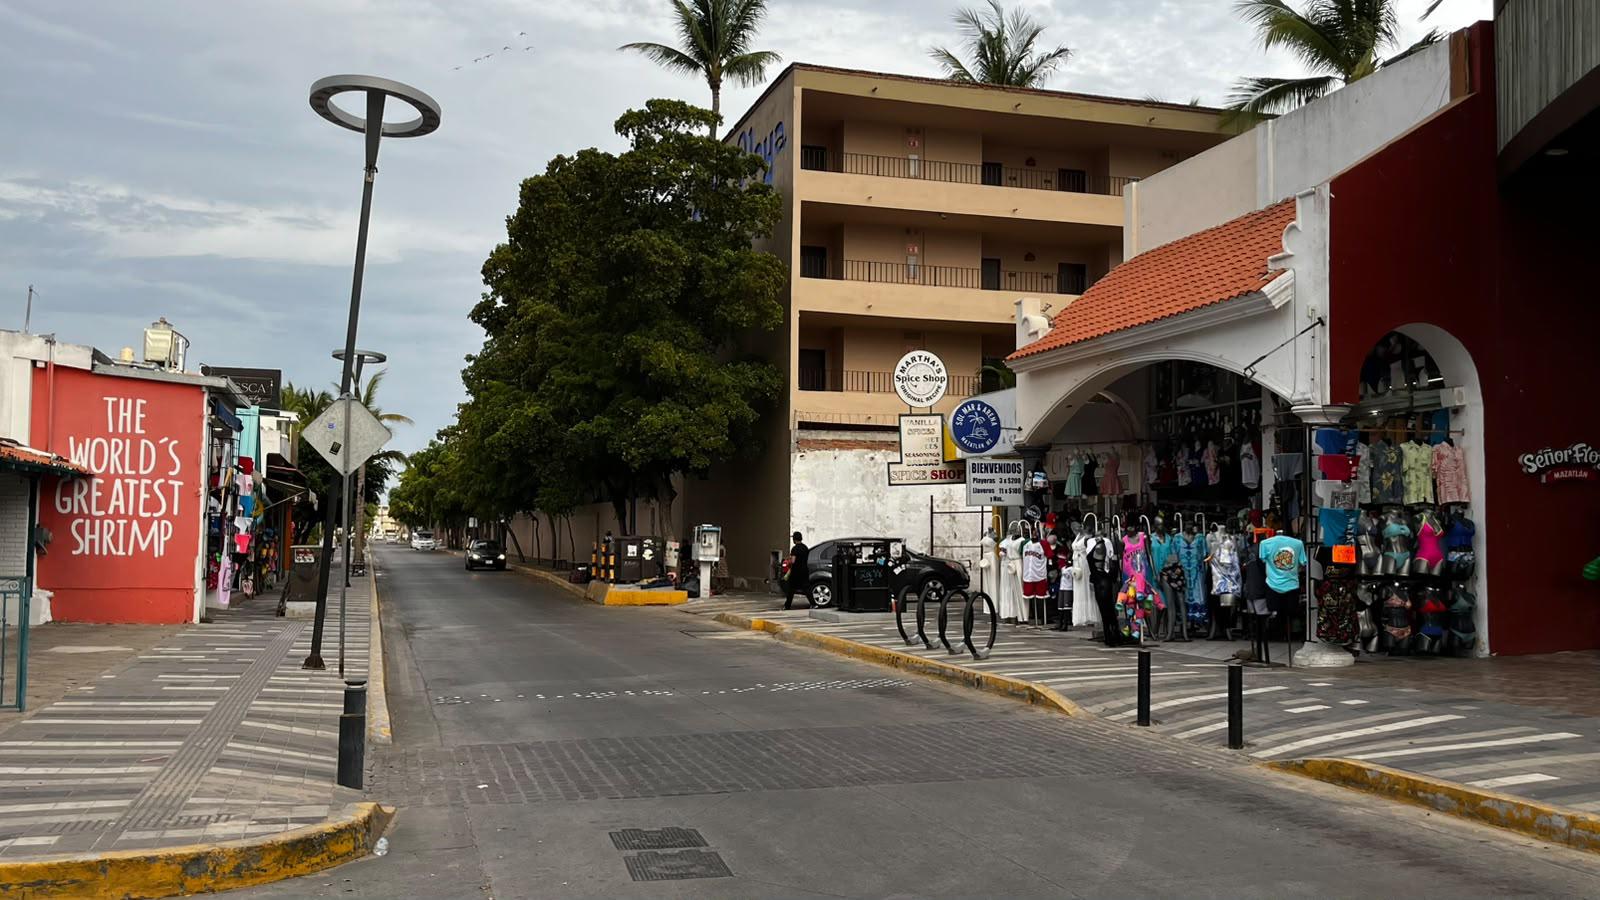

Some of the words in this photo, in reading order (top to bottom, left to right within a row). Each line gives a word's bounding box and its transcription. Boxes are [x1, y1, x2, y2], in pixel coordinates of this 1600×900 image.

[900, 355, 942, 374] MARTHA'S
[235, 382, 266, 393] SCA
[895, 374, 921, 383] Spice
[922, 374, 946, 384] Shop
[900, 384, 924, 402] ORIGINAL
[925, 385, 942, 402] RECIPE
[103, 397, 146, 433] THE
[955, 413, 965, 426] SOL
[961, 403, 975, 415] MAR
[981, 406, 998, 427] ARENA
[960, 436, 985, 449] MAZATLAN
[1523, 448, 1572, 473] Señor
[1572, 443, 1600, 470] Fro
[890, 470, 927, 481] SPICE
[930, 469, 965, 480] SHOP
[971, 462, 1021, 474] BIENVENIDOS
[972, 477, 996, 485] Playeras
[55, 478, 183, 517] GREATEST
[71, 519, 173, 558] SHRIMP
